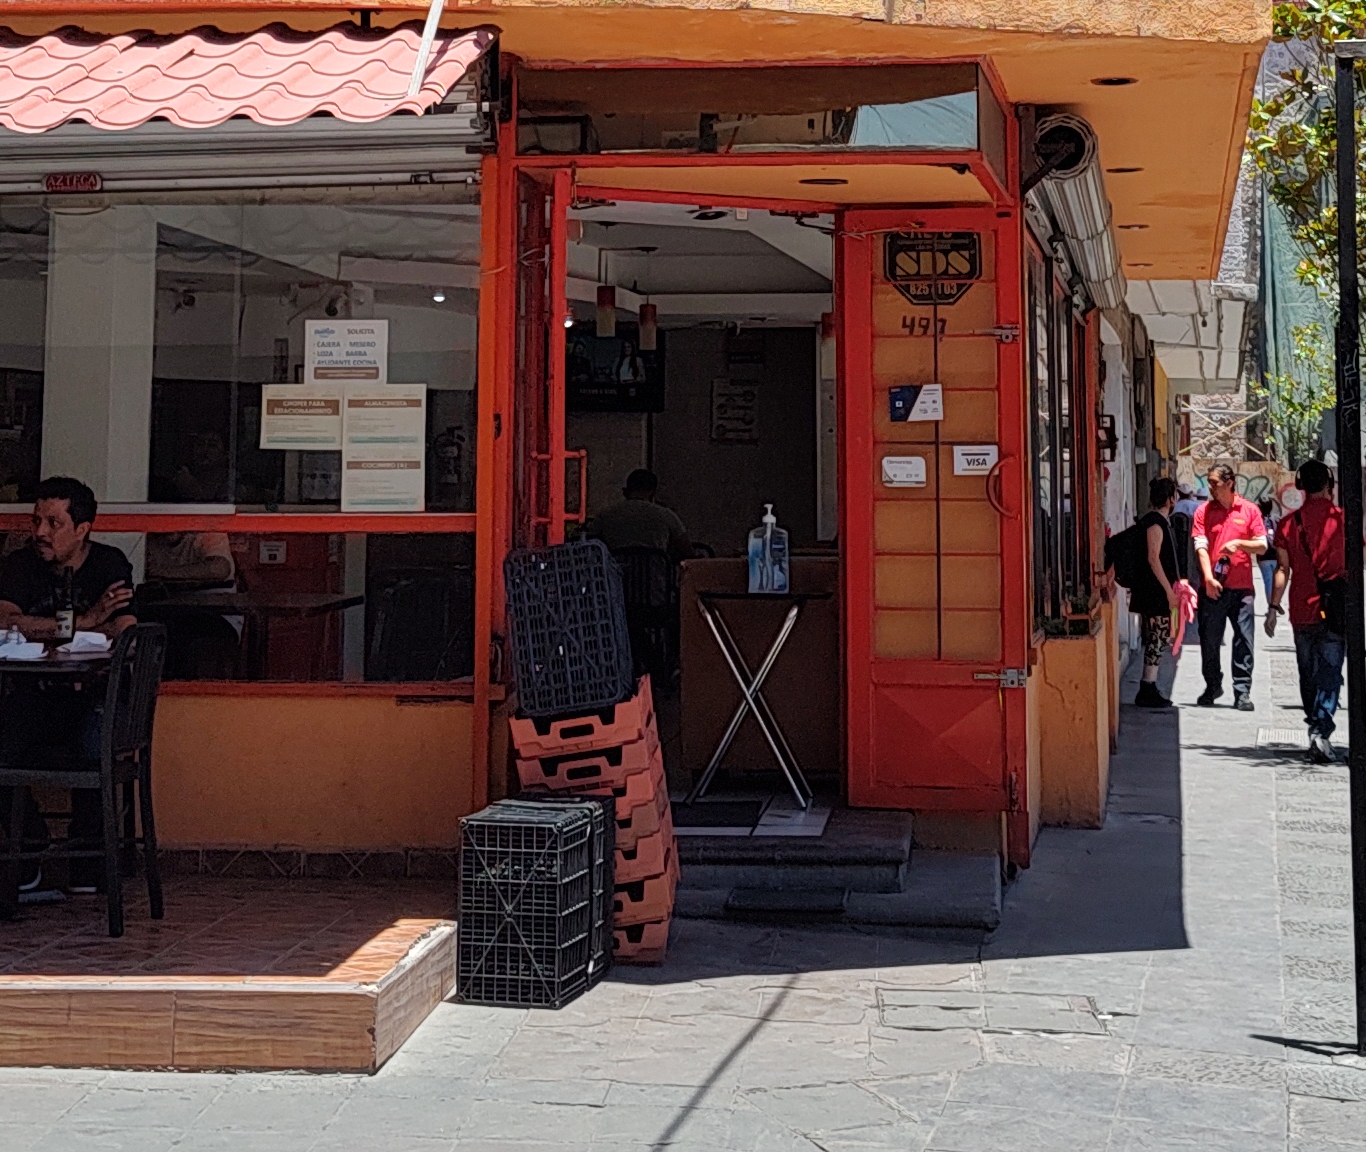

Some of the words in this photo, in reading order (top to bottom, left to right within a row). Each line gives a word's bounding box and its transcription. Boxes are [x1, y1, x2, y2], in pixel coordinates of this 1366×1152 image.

[47, 174, 97, 186] AZTECA
[896, 251, 971, 275] SDS
[909, 283, 929, 295] 825
[966, 458, 987, 467] VISA
